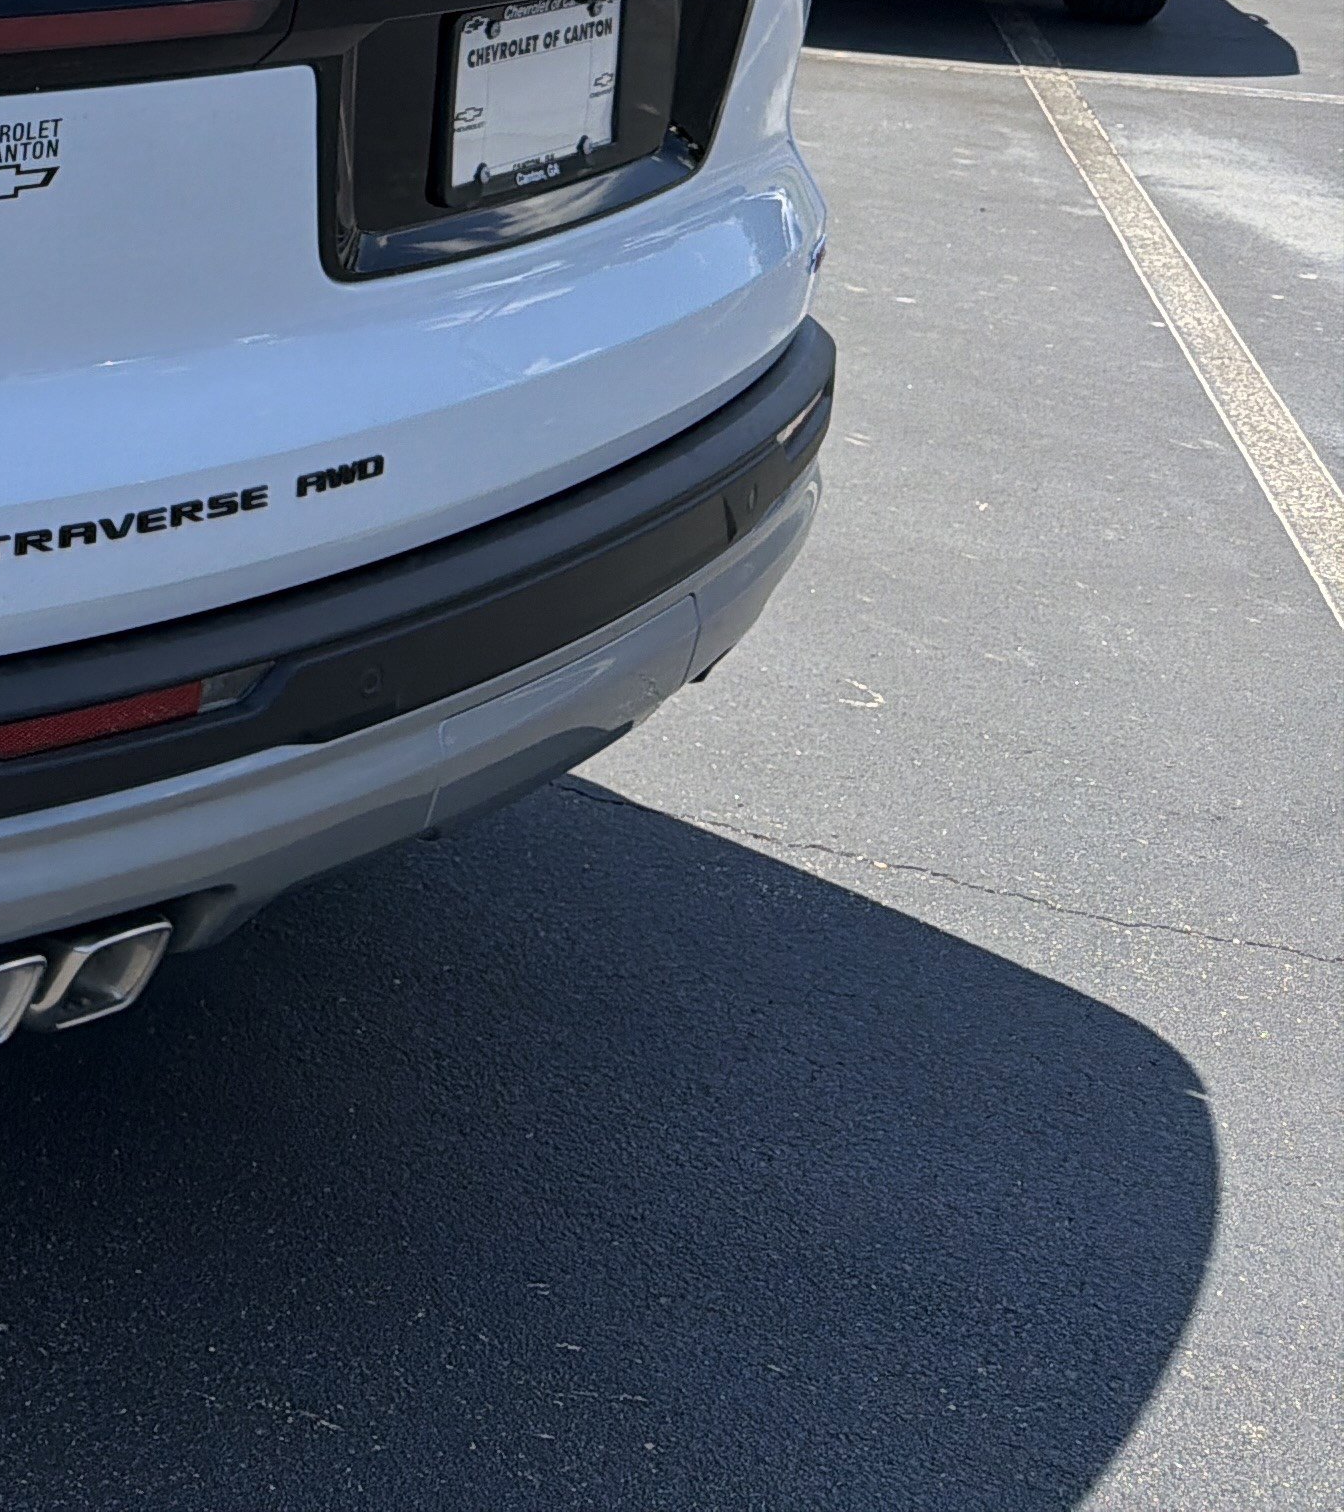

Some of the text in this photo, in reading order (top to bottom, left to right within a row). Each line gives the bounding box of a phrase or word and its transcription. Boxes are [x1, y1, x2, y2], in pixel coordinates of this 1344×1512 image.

[467, 17, 612, 68] CHEVROLET OF CANTON
[296, 454, 385, 498] AWD
